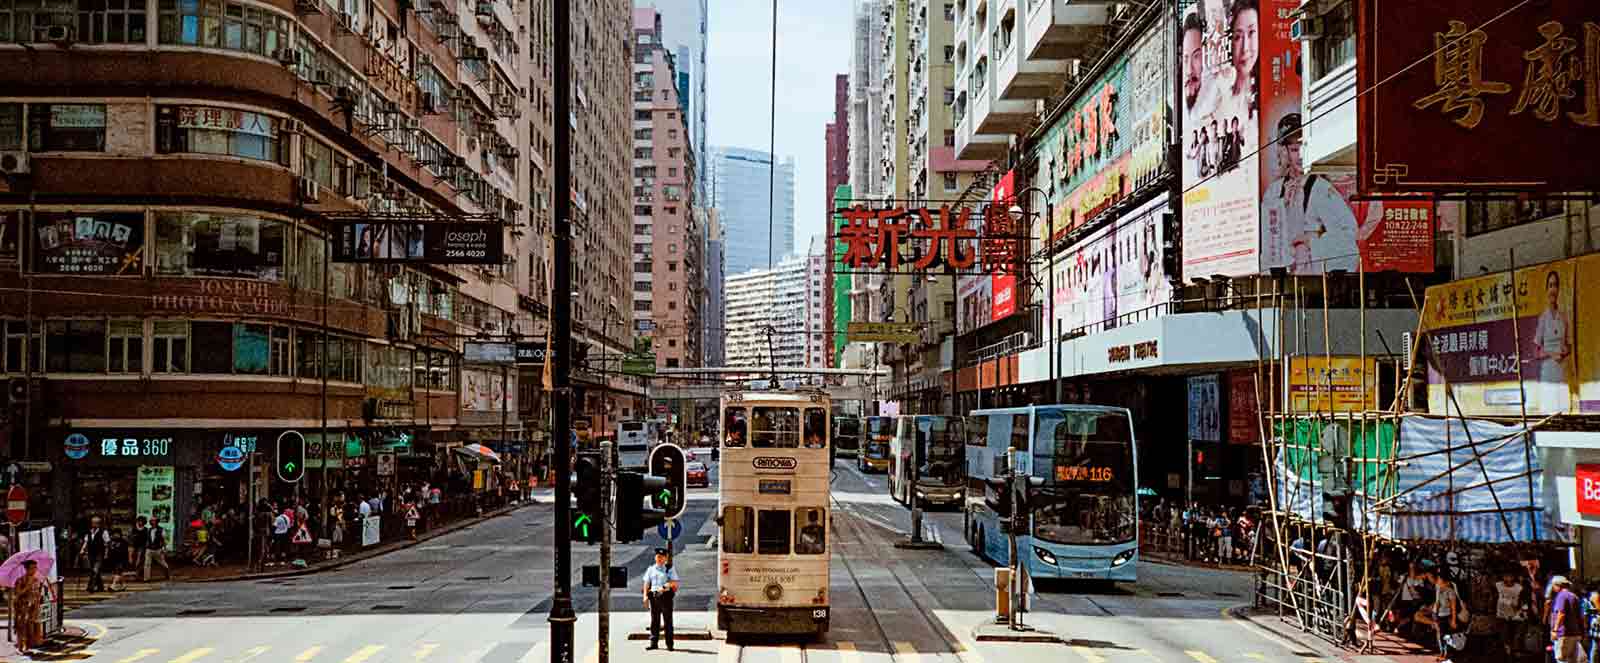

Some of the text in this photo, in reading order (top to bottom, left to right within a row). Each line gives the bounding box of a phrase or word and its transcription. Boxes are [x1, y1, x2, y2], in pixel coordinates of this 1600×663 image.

[1413, 20, 1600, 128] 粵劇
[840, 204, 977, 269] 新光
[446, 249, 485, 257] 2566 4020
[200, 279, 270, 297] JOSEPH
[1089, 466, 1113, 481] 116
[812, 610, 827, 619] 138
